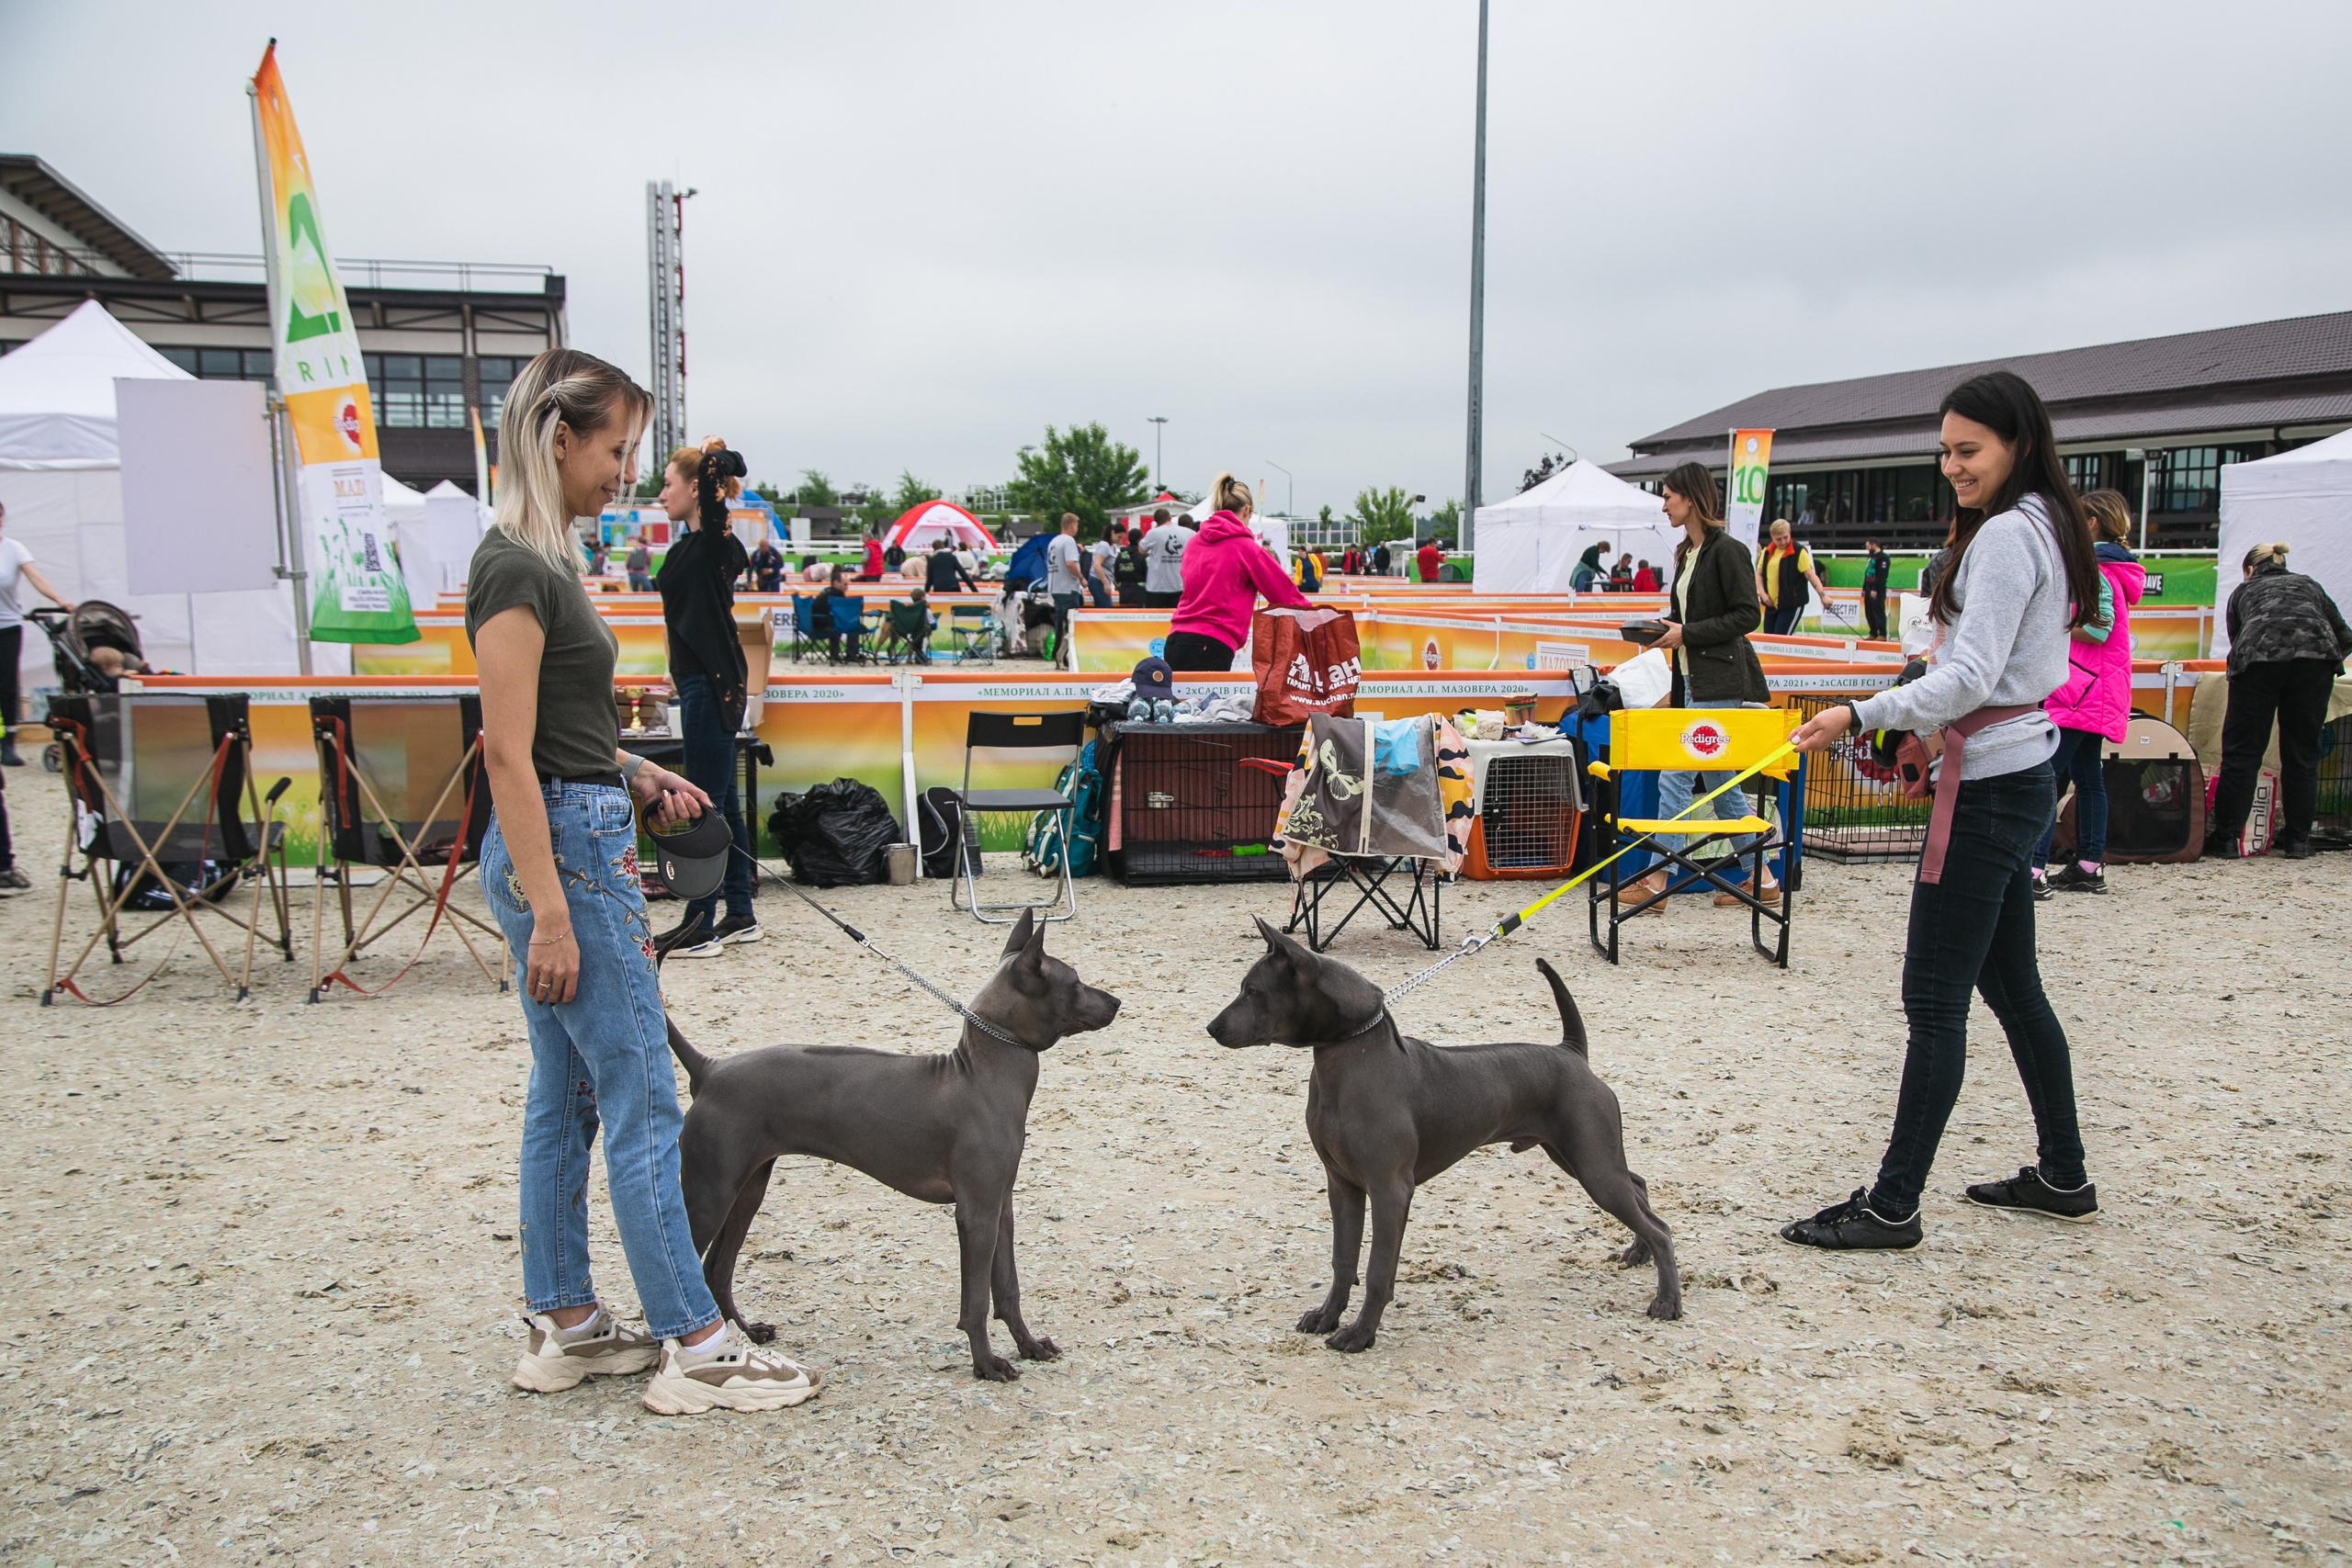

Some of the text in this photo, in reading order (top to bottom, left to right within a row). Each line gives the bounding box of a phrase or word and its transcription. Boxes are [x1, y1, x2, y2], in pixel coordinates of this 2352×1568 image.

[1736, 465, 1767, 504] 10
[1287, 676, 1315, 693] ГАРАНТ
[1783, 679, 1809, 687] 2021»
[1819, 679, 1859, 687] 2xCACIB
[1860, 679, 1876, 687] FCI
[813, 689, 844, 698] 2020»
[978, 687, 1049, 696] «МЕМОРИАЛ
[1053, 687, 1077, 696] А.П.
[1185, 686, 1250, 695] 2xCACIB FCI
[1417, 685, 1438, 694] А.П.
[1442, 684, 1498, 694] МАЗОВЕРА
[1500, 684, 1529, 694] 2020»
[1289, 692, 1355, 706] www.auchan.r
[1679, 733, 1730, 745] Pedigree
